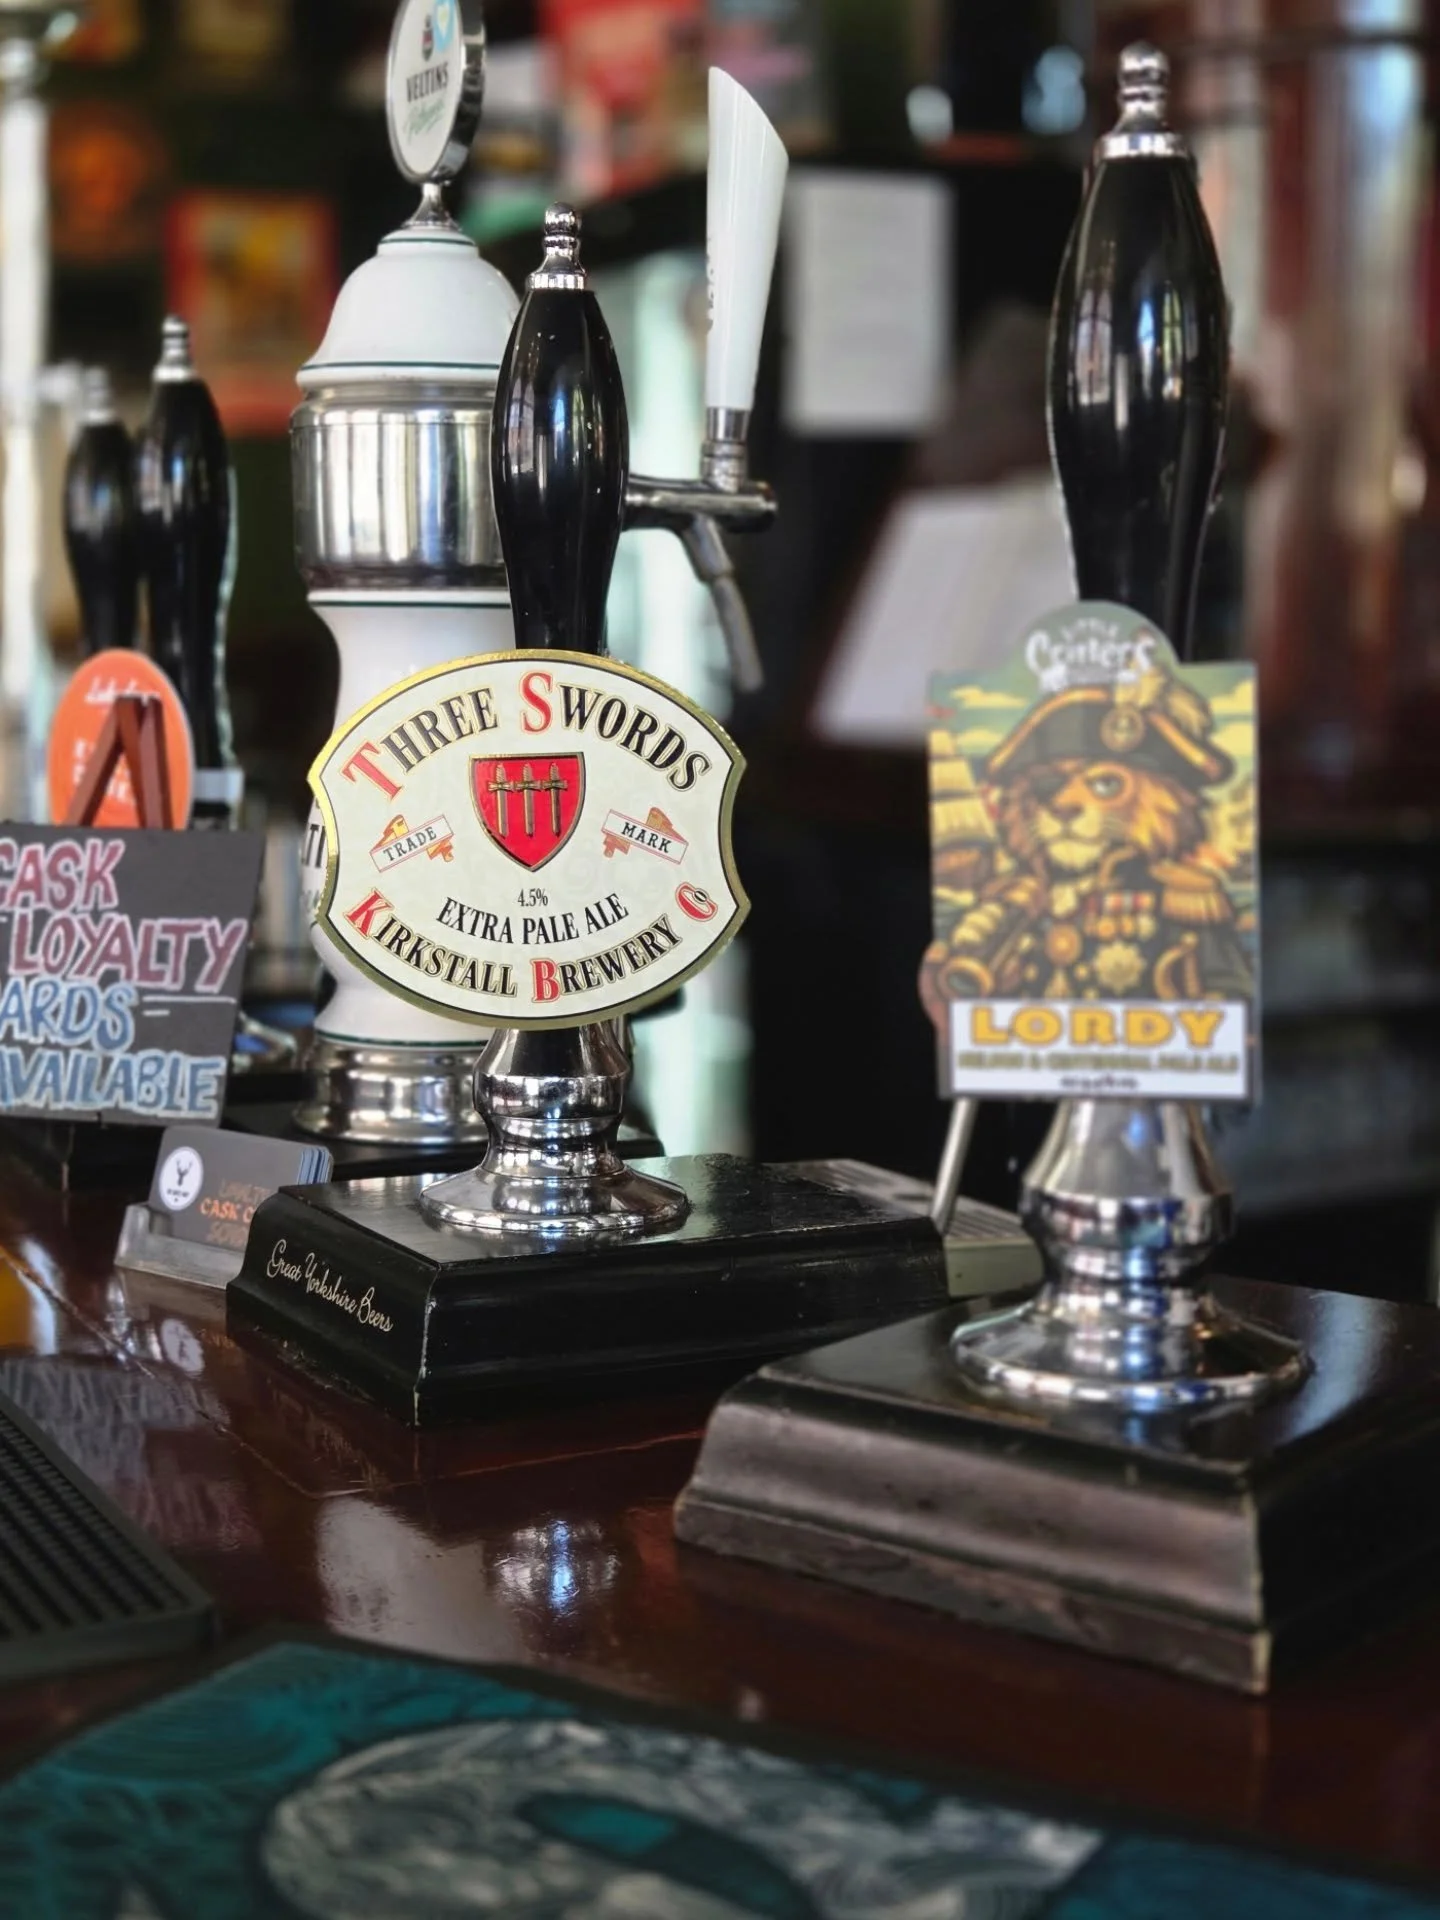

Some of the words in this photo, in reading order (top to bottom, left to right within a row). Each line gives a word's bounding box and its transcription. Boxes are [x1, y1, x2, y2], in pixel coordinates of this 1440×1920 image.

[407, 62, 449, 103] VELTINS
[340, 686, 500, 802] THREE
[519, 670, 713, 793] SWORDS
[0, 838, 126, 913] CASK
[382, 825, 438, 863] TRADE
[620, 821, 672, 854] MARK
[435, 896, 514, 944] EXTRA
[522, 911, 580, 945] PALE
[586, 892, 629, 936] ALE
[516, 887, 549, 907] 4.5%
[8, 911, 248, 994] LOYALTY
[344, 886, 518, 998] KIRKSTALL
[530, 914, 683, 1005] BREWERY
[0, 975, 138, 1052] ARDS
[969, 1004, 1225, 1049] LORDY
[0, 1046, 228, 1119] VAILABLE
[266, 1238, 303, 1279] Great
[304, 1252, 357, 1314] Yorkshire
[356, 1286, 394, 1333] Beers
